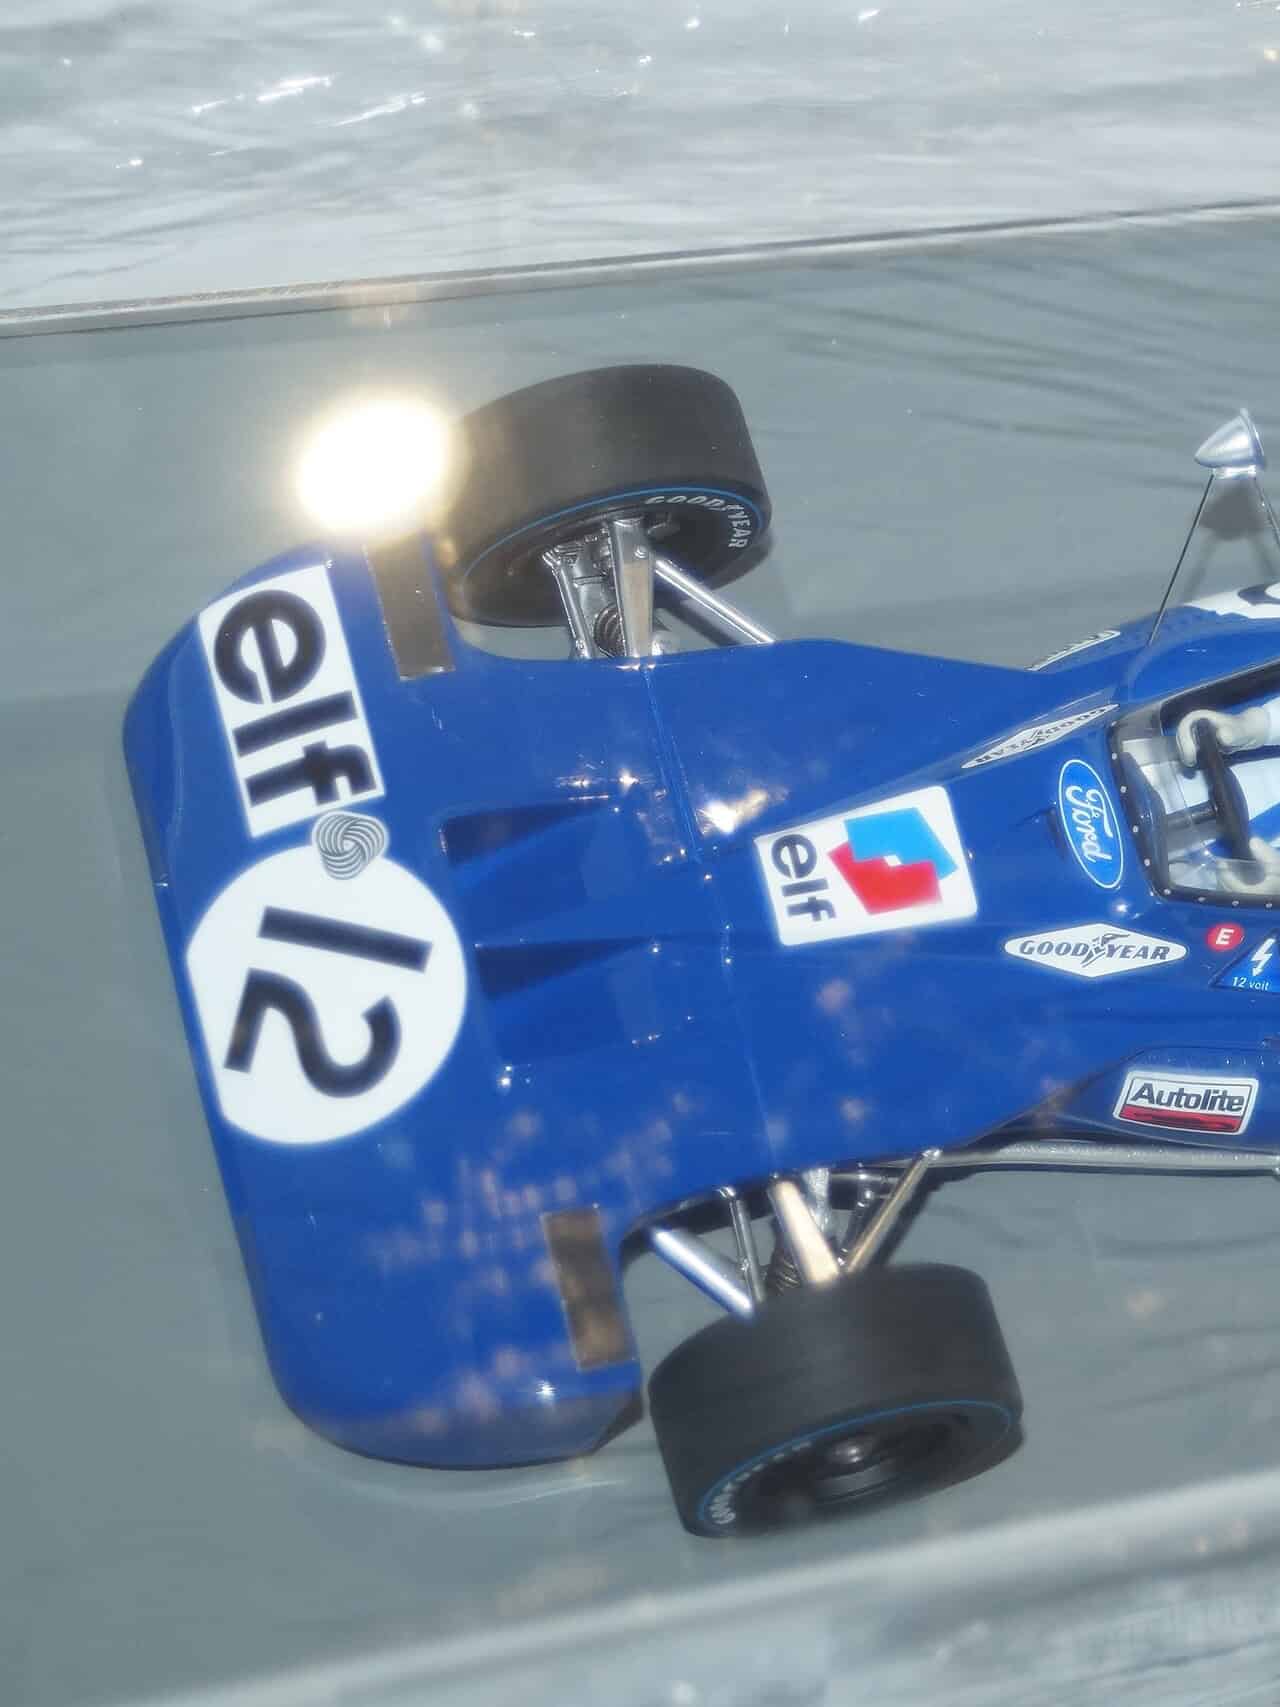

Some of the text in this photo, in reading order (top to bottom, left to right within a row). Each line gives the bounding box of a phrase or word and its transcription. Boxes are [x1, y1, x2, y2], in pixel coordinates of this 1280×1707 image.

[214, 588, 378, 808] elf
[1064, 784, 1114, 864] Ford
[771, 833, 837, 922] elf
[224, 905, 433, 1099] 12
[1232, 976, 1248, 989] 12
[1130, 1082, 1245, 1112] Autolite
